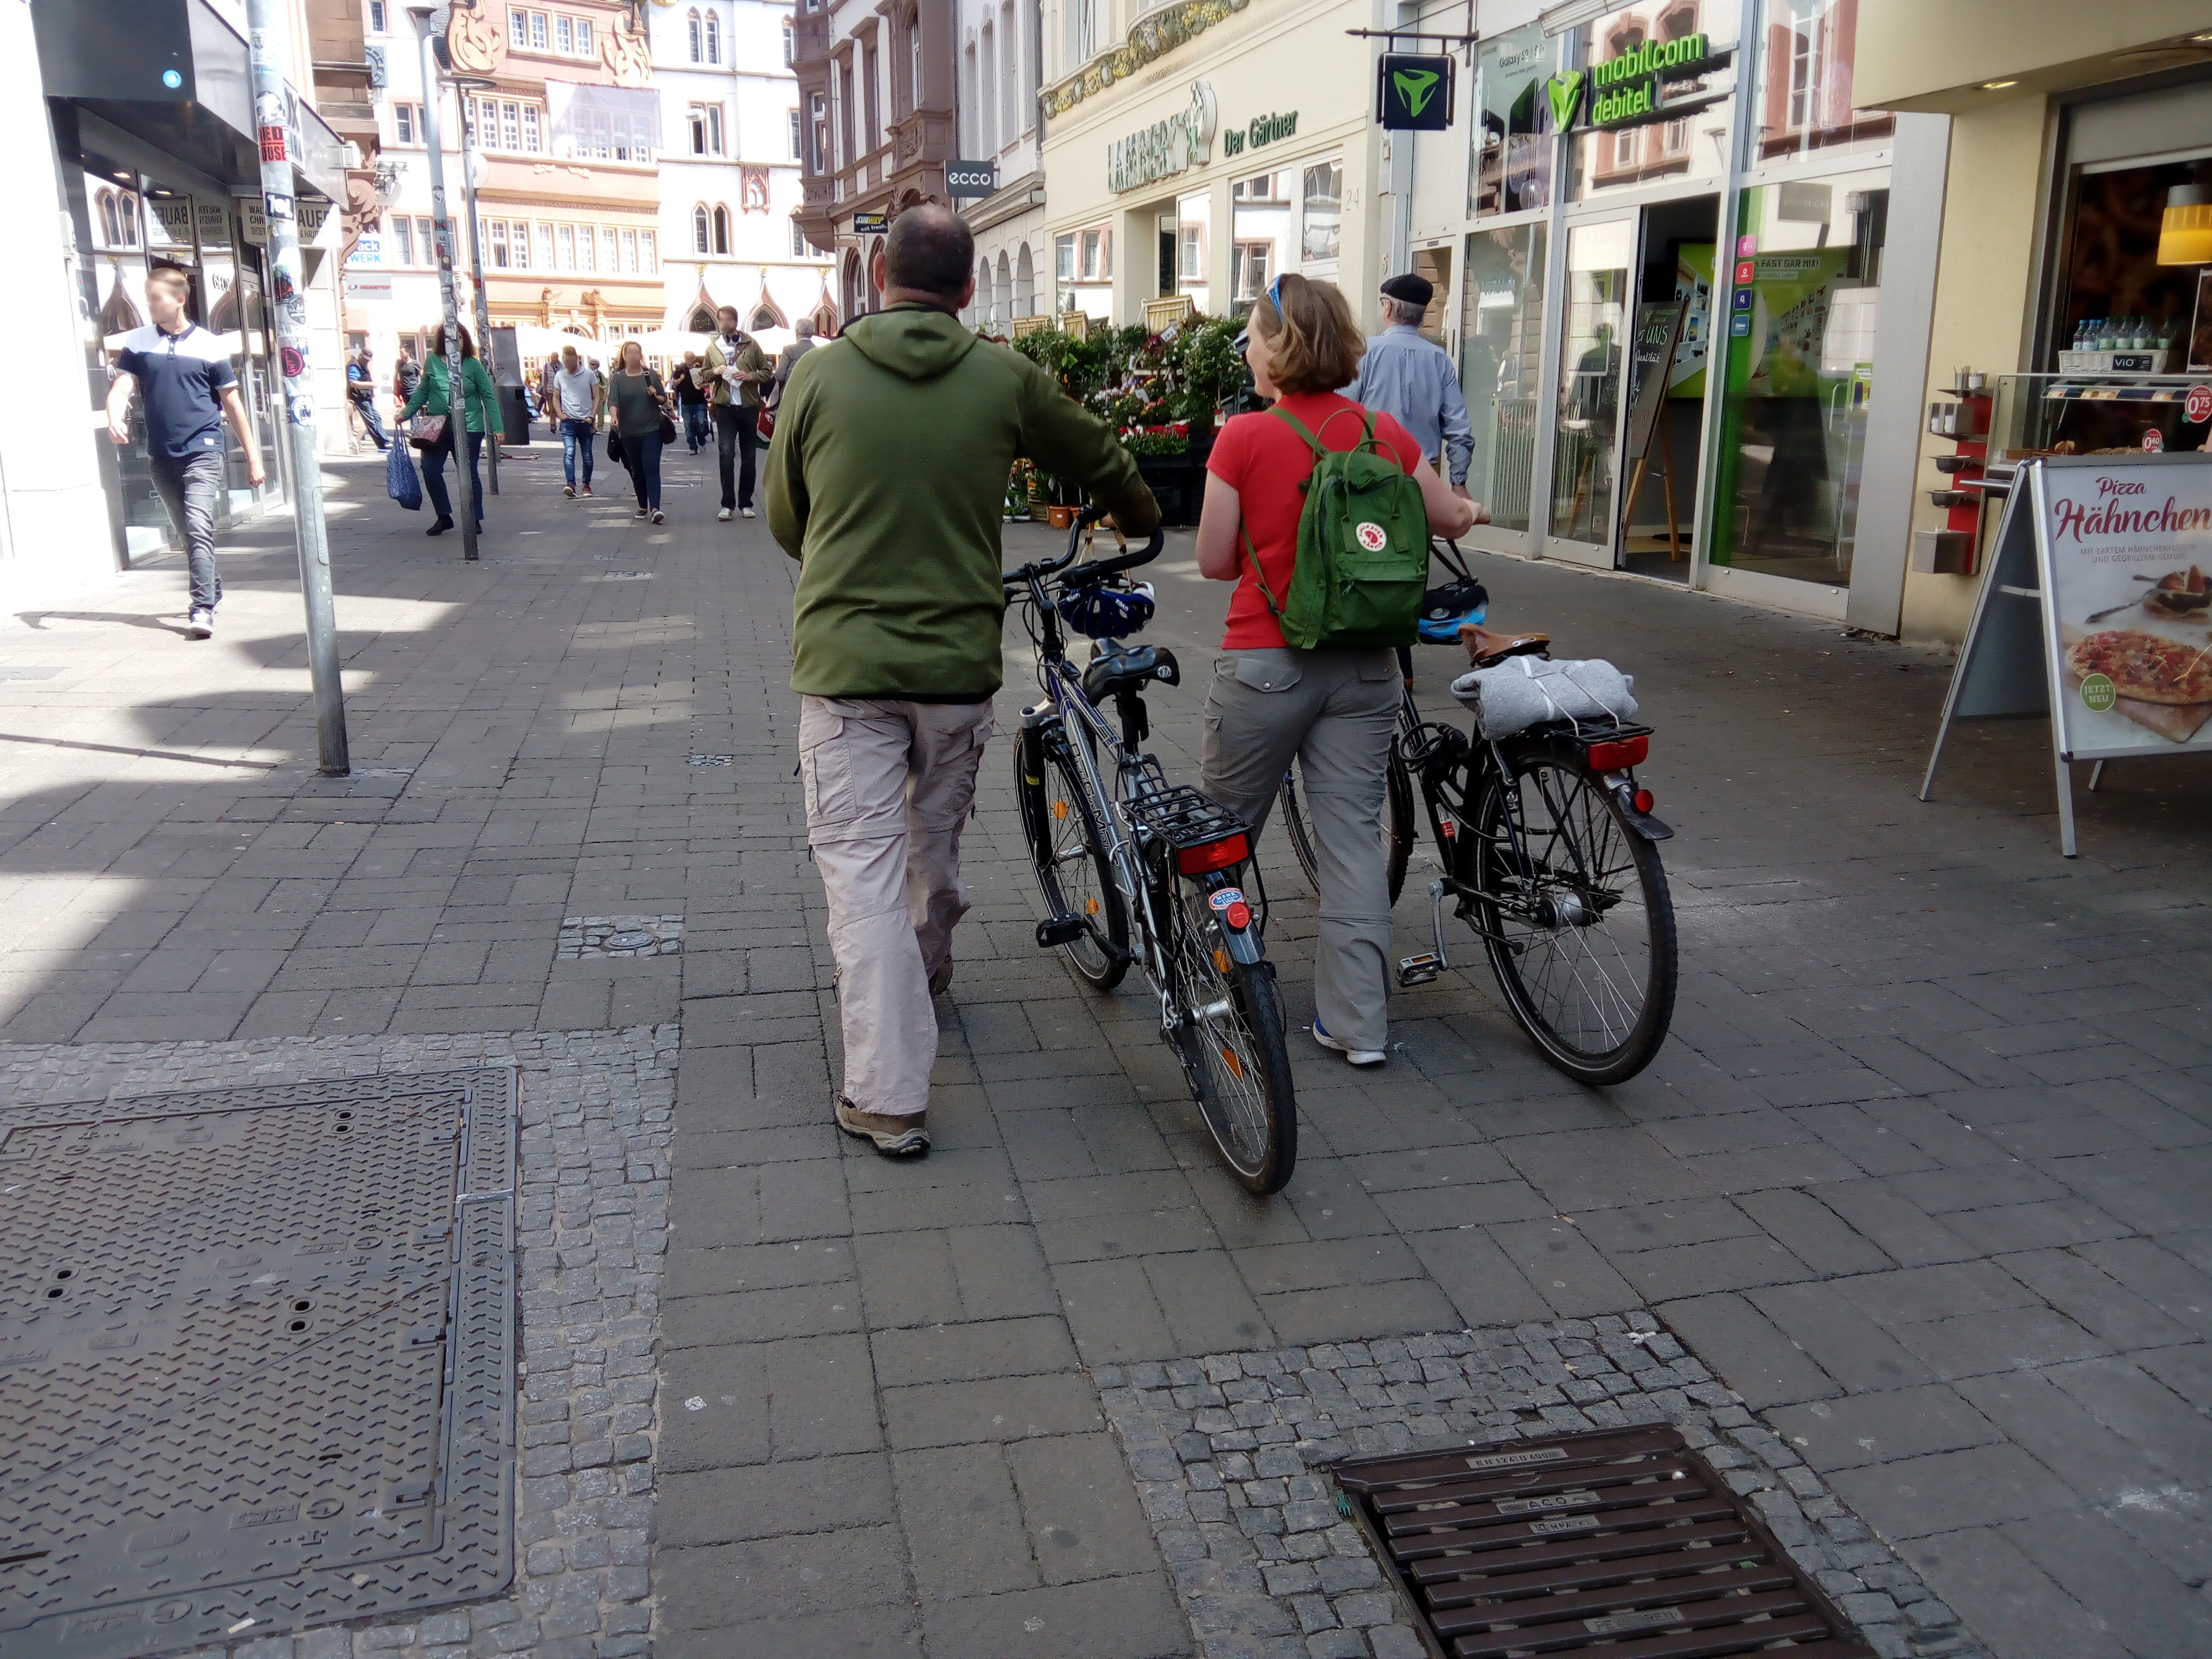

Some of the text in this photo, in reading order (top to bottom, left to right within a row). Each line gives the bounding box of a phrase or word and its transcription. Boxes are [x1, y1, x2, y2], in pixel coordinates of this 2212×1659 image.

[1499, 53, 1521, 68] Galaxy
[1595, 33, 1703, 88] mobilcom
[1593, 81, 1652, 125] debitel
[1224, 110, 1298, 157] Der Gärtner
[949, 172, 991, 185] ecco
[856, 215, 884, 224] SUBWAY
[1762, 260, 1782, 268] FAST
[1784, 259, 1801, 268] GAR
[1646, 325, 1668, 346] UNS
[2095, 476, 2146, 499] Pizza
[2055, 496, 2212, 543] Hähnchen
[2096, 546, 2126, 554] ZARTEM
[2093, 555, 2109, 563] UND
[2112, 554, 2155, 562] GEGRILLTEM
[2085, 684, 2110, 695] JETZT
[2089, 695, 2109, 703] NEU
[1529, 1496, 1568, 1509] ACO
